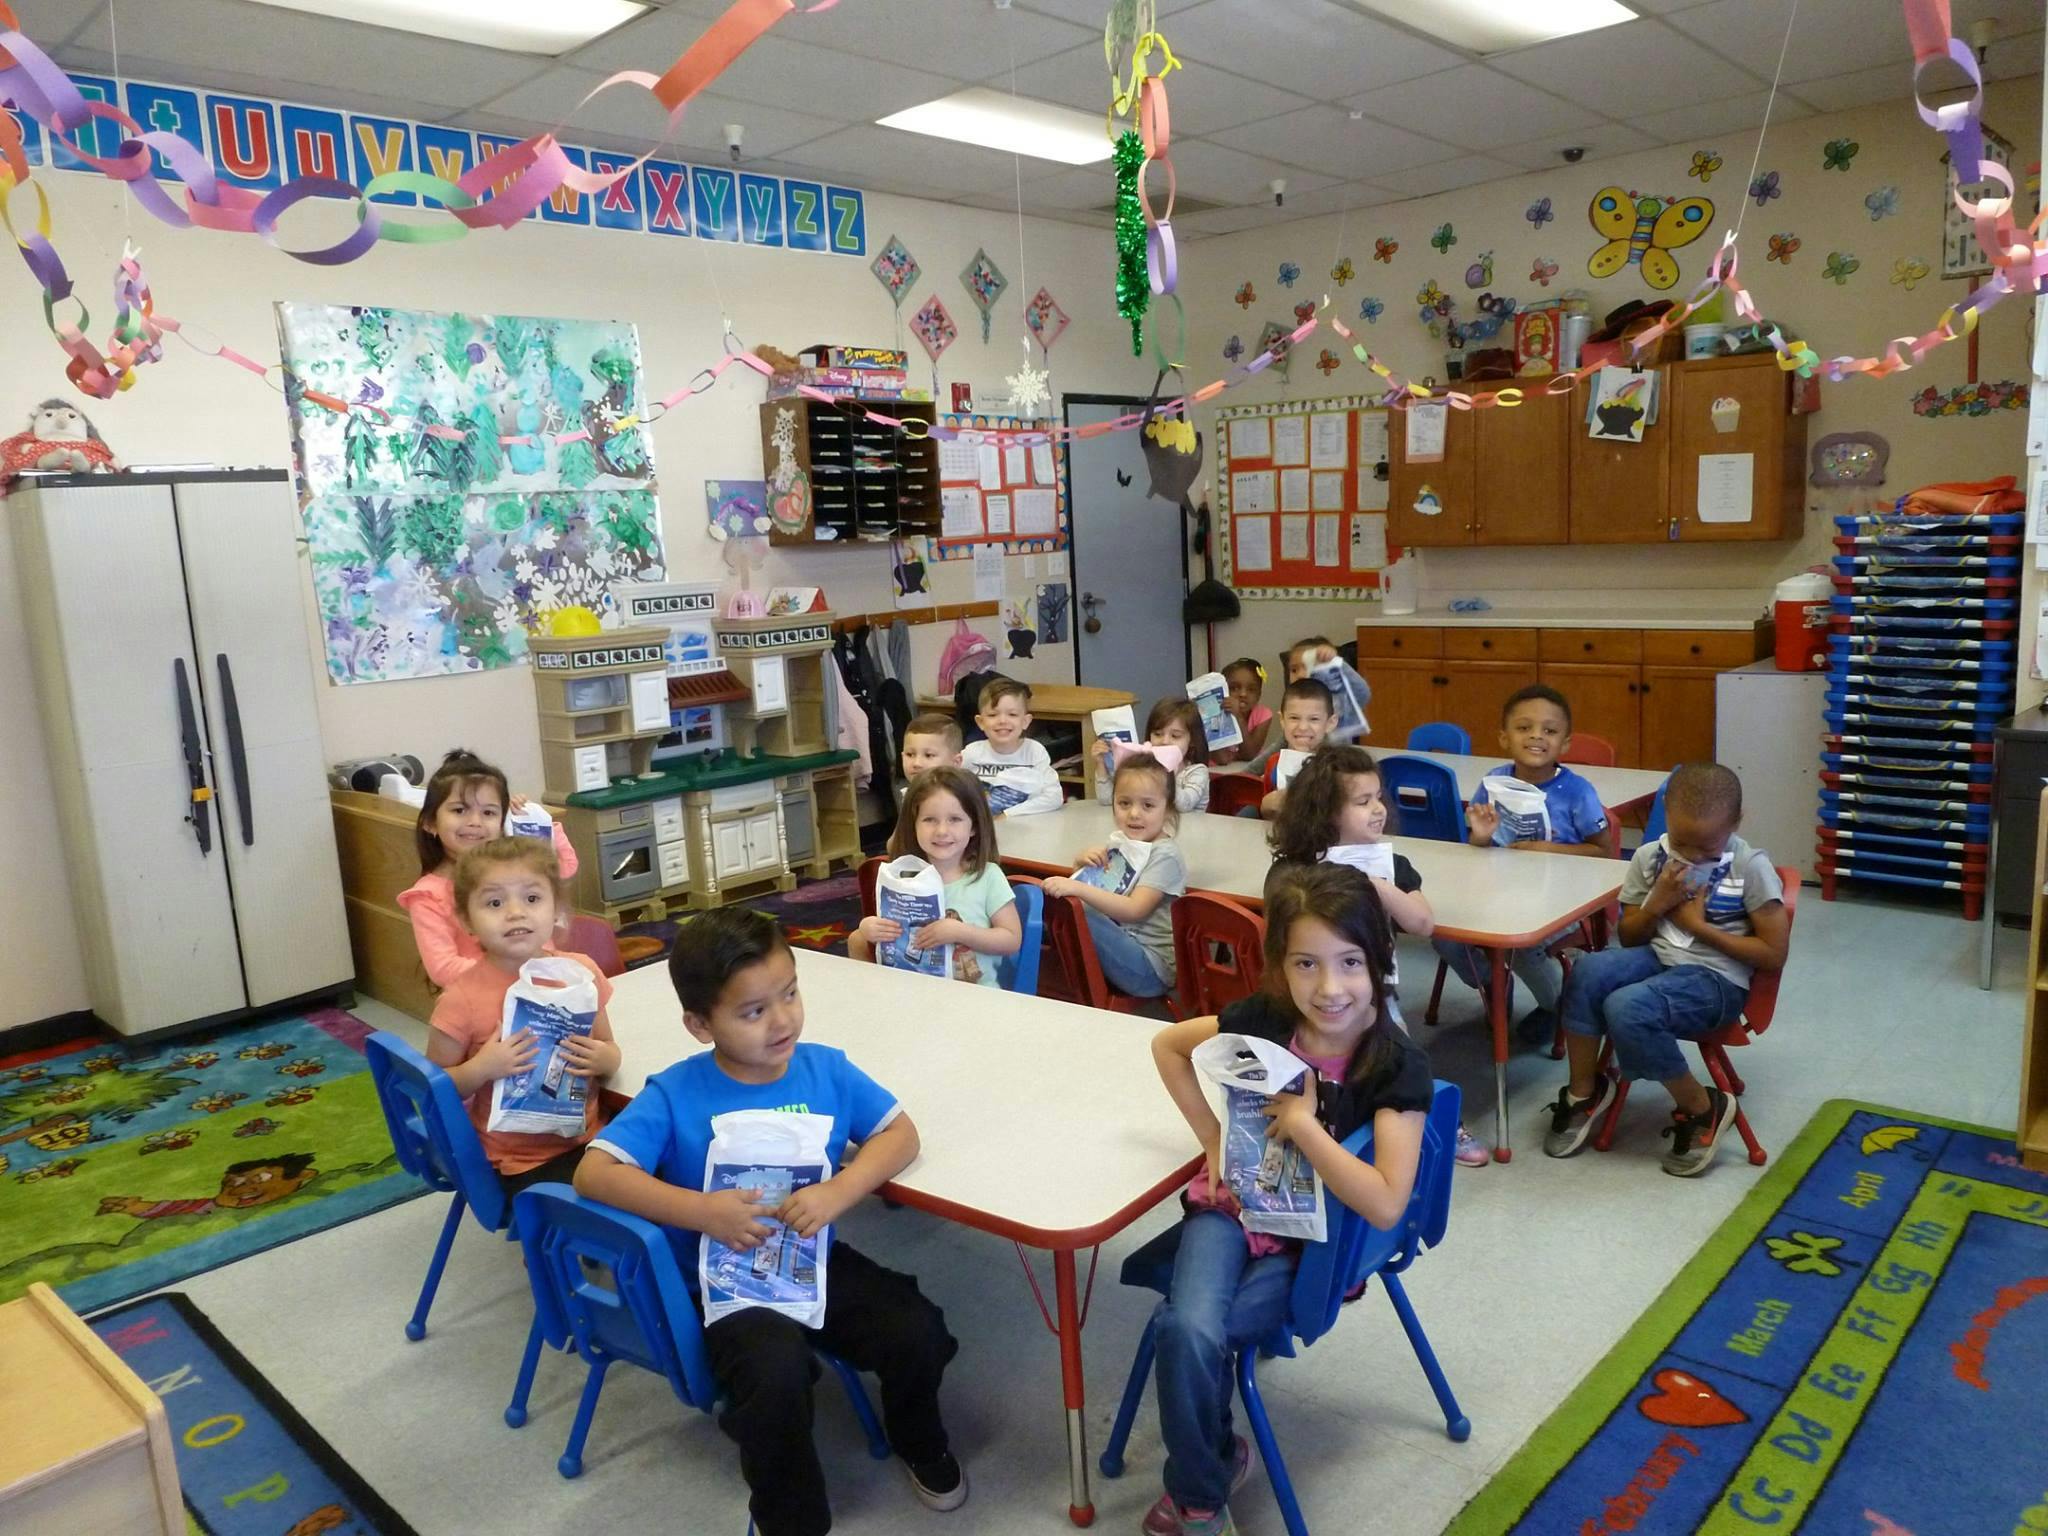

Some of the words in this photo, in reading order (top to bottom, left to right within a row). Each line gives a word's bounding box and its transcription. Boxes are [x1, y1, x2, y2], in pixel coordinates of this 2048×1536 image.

[149, 99, 182, 169] t
[214, 104, 272, 180] U
[294, 129, 338, 181] u
[355, 122, 405, 195] V
[648, 169, 687, 231] X
[696, 174, 731, 232] Y
[832, 195, 859, 250] Z
[41, 1127, 82, 1145] 10
[1839, 1171, 1887, 1209] April
[1899, 1220, 1950, 1251] Hh
[1868, 1262, 1932, 1294] Gg
[1726, 1298, 1793, 1358] March
[1847, 1305, 1897, 1343] Ff
[1808, 1362, 1867, 1402] Ee
[183, 1414, 246, 1448] O
[1769, 1410, 1833, 1465] Dd
[223, 1472, 289, 1508] P
[1728, 1476, 1794, 1525] Cc
